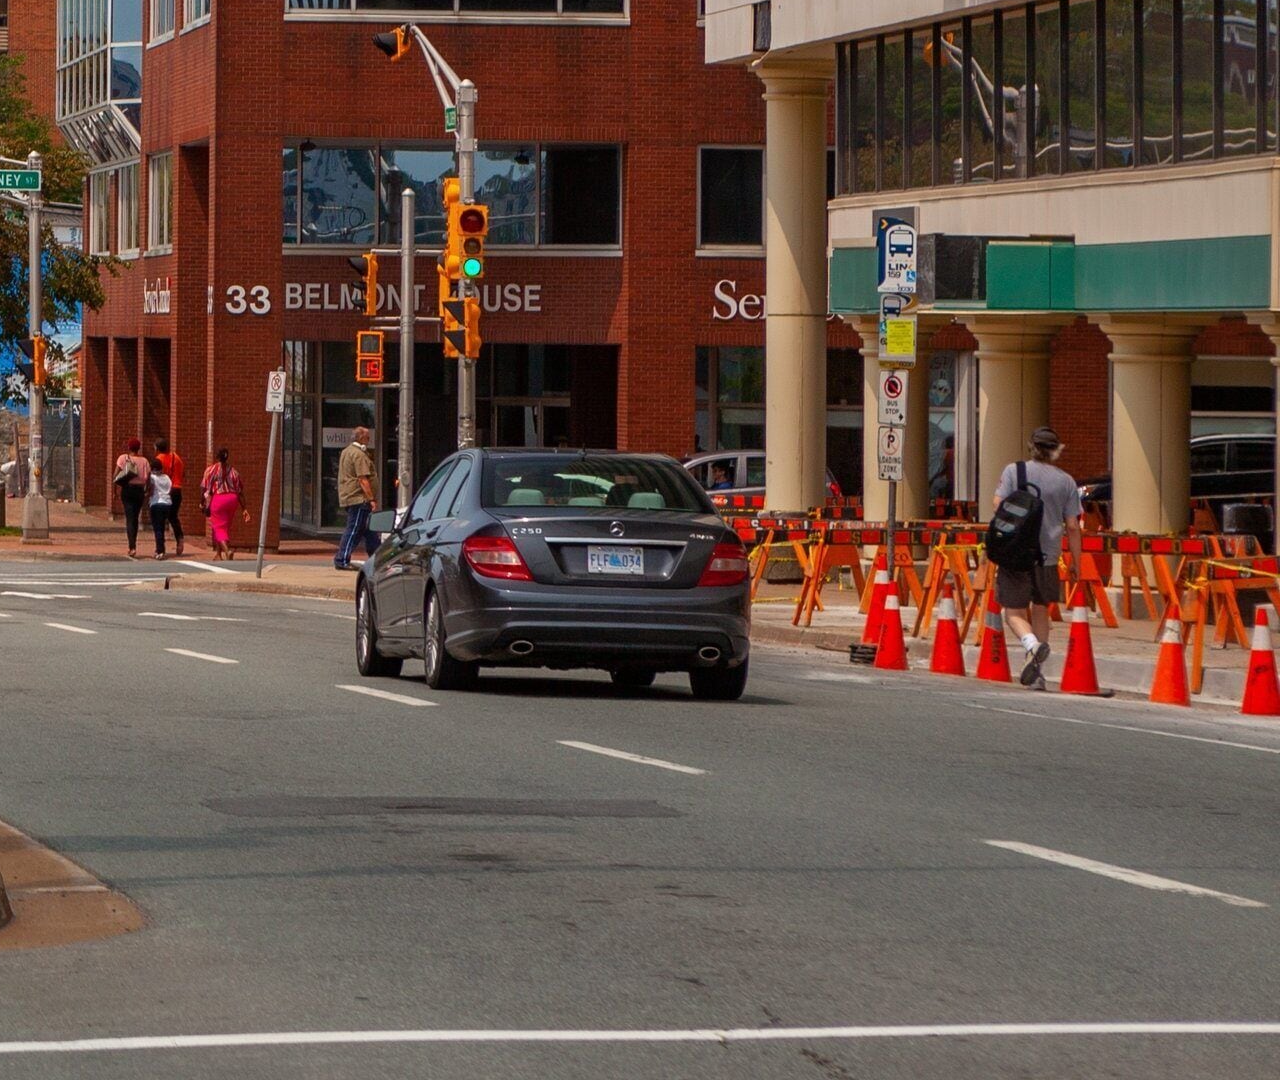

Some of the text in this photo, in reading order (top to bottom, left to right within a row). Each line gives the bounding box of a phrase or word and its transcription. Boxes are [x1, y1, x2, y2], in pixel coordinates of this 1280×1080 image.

[225, 284, 271, 315] 33
[880, 456, 902, 465] LOADING
[883, 465, 898, 474] ZONE
[512, 527, 542, 535] C 250
[590, 555, 642, 568] FLF 034
